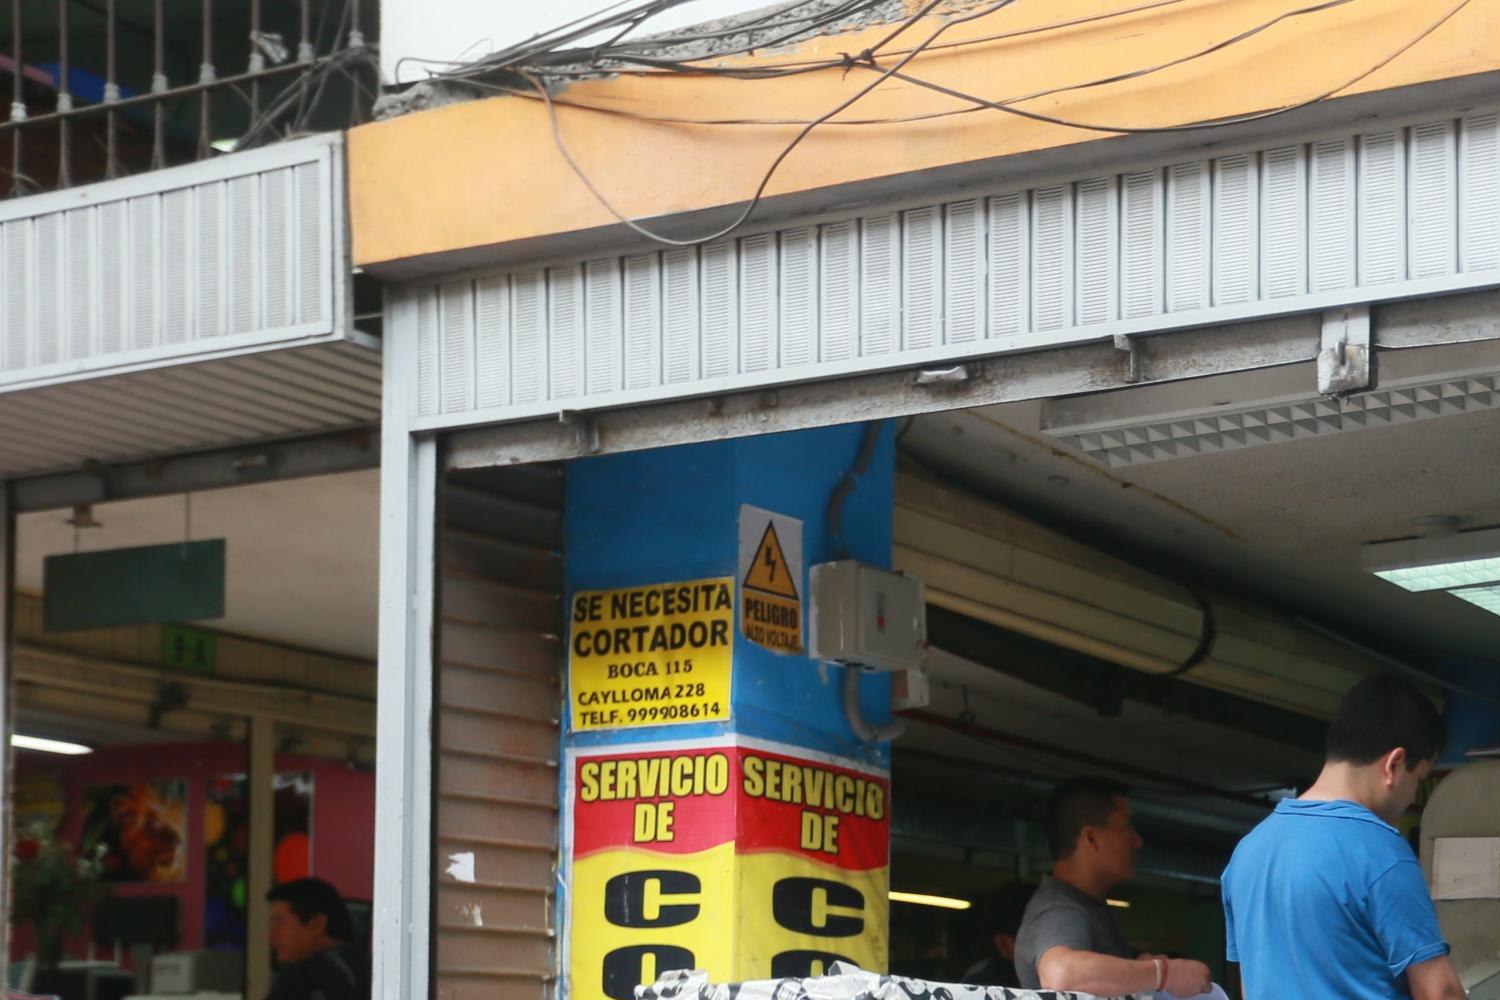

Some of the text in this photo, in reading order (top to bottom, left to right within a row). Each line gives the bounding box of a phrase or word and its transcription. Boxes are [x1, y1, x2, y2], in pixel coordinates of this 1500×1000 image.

[574, 583, 732, 623] SE NECESITA
[745, 597, 798, 630] PELIGRO
[574, 619, 728, 658] CORTADOR
[607, 659, 693, 679] BOCA 115
[578, 683, 705, 706] CAYLLOMA 228
[580, 702, 720, 726] TELF. 999908614
[580, 753, 729, 802] SERVICIO
[743, 756, 884, 820] SERVICIO
[633, 802, 674, 843] DE
[801, 811, 839, 854] DE
